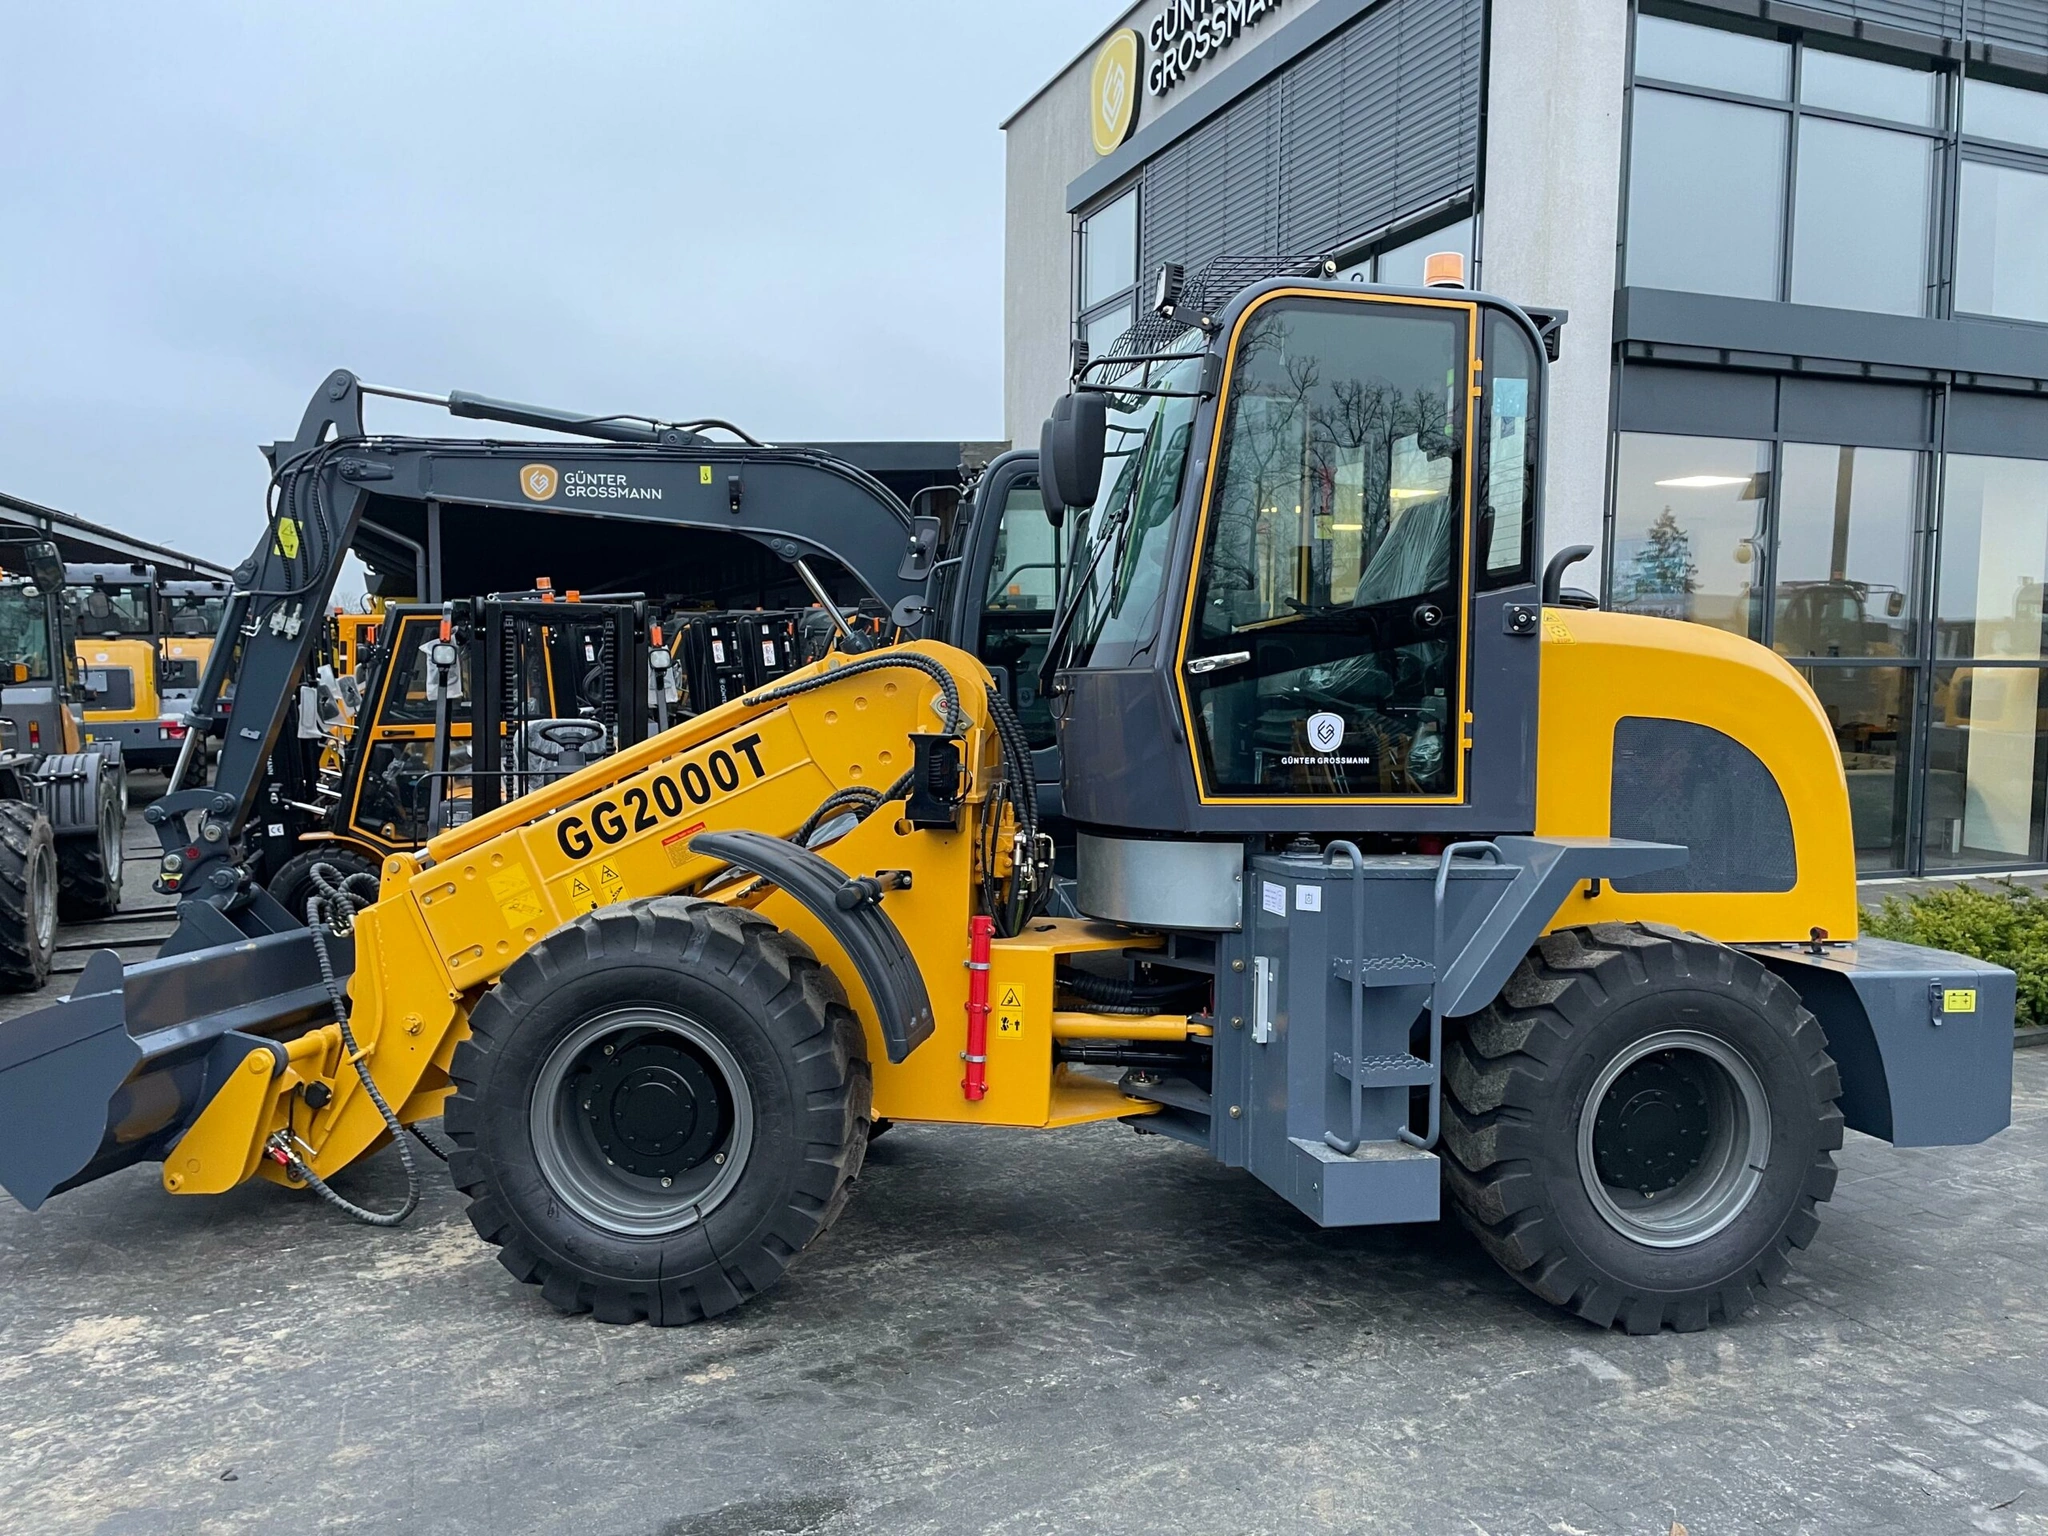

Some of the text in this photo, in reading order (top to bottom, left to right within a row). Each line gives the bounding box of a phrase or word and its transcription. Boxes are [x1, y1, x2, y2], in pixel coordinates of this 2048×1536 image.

[1148, 0, 1273, 97] GROSSMA
[564, 470, 627, 486] GÜNTER
[564, 485, 662, 500] GROSSMANN
[1281, 755, 1370, 765] GÜNTER GROSSMANN
[557, 733, 765, 860] GG2000T
